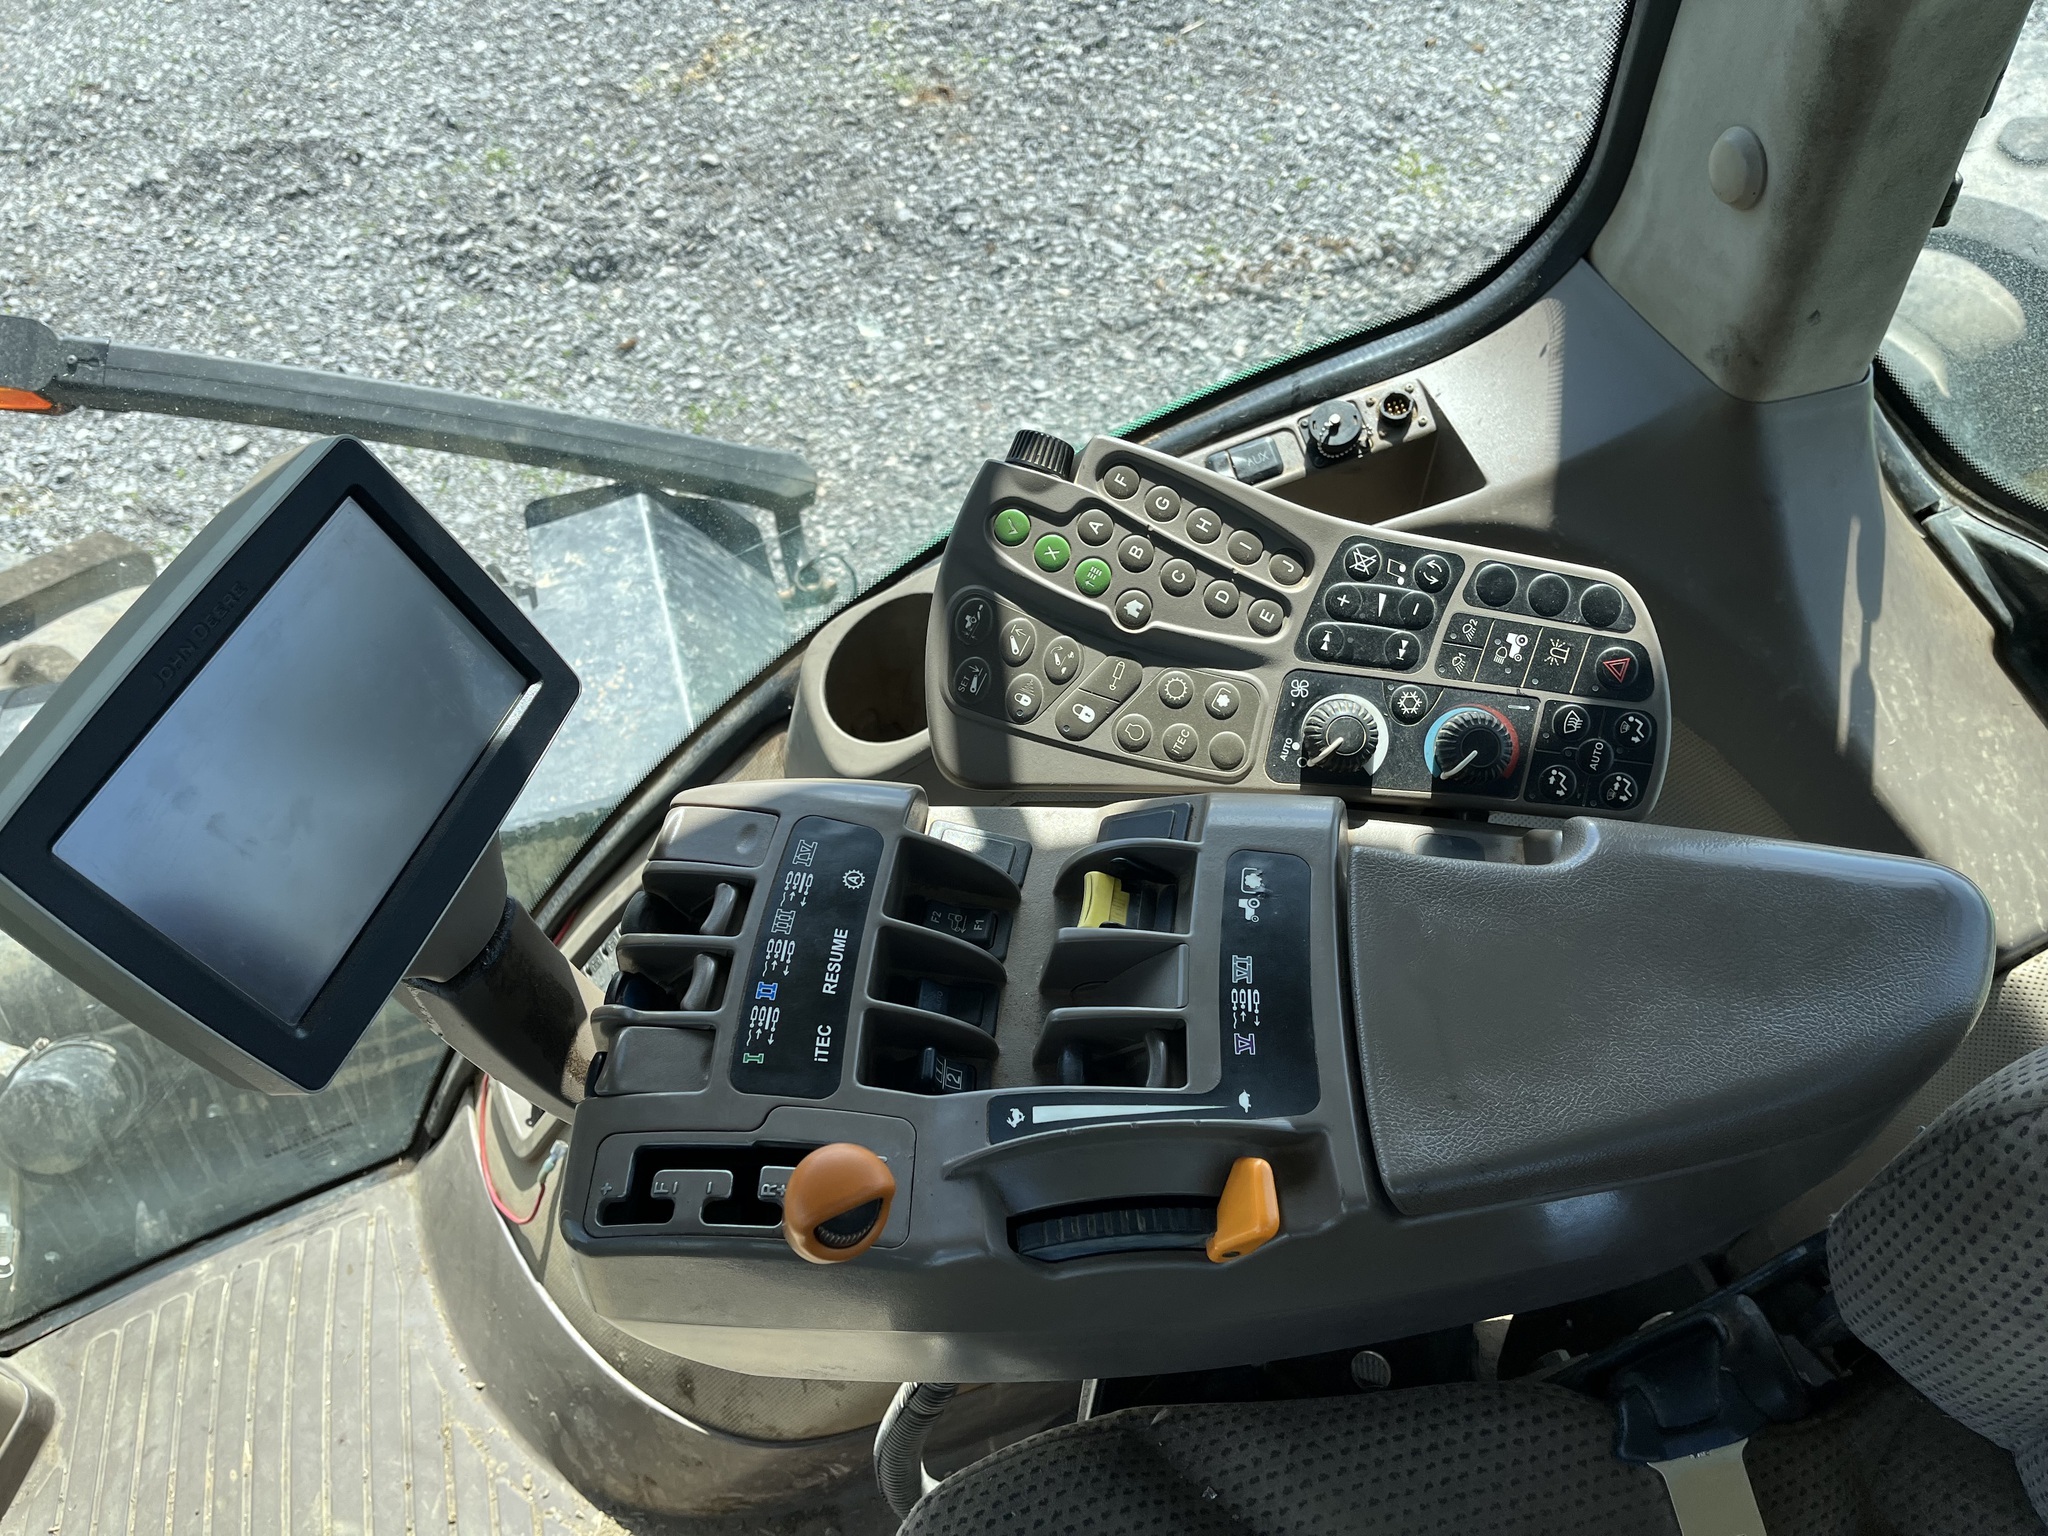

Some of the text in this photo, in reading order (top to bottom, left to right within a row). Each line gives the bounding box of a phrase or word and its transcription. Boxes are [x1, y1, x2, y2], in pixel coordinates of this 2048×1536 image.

[1246, 450, 1270, 466] AUX
[1115, 473, 1129, 488] F
[1155, 496, 1171, 512] G
[1088, 520, 1105, 535] A
[1196, 517, 1213, 534] H
[1128, 545, 1145, 561] B
[1239, 541, 1253, 551] I
[1285, 559, 1298, 574] J
[1171, 568, 1187, 584] C
[1214, 589, 1231, 605] D
[1259, 608, 1276, 624] E
[153, 581, 249, 688] JOHN DEERE
[957, 674, 970, 693] SET
[1170, 728, 1191, 756] iTEC
[1278, 736, 1294, 763] AUTO
[1588, 741, 1605, 771] AUTO
[930, 910, 943, 924] F2
[973, 918, 985, 931] F1
[822, 928, 849, 995] RESUME
[814, 1024, 833, 1063] iTEC
[946, 1072, 961, 1085] 2
